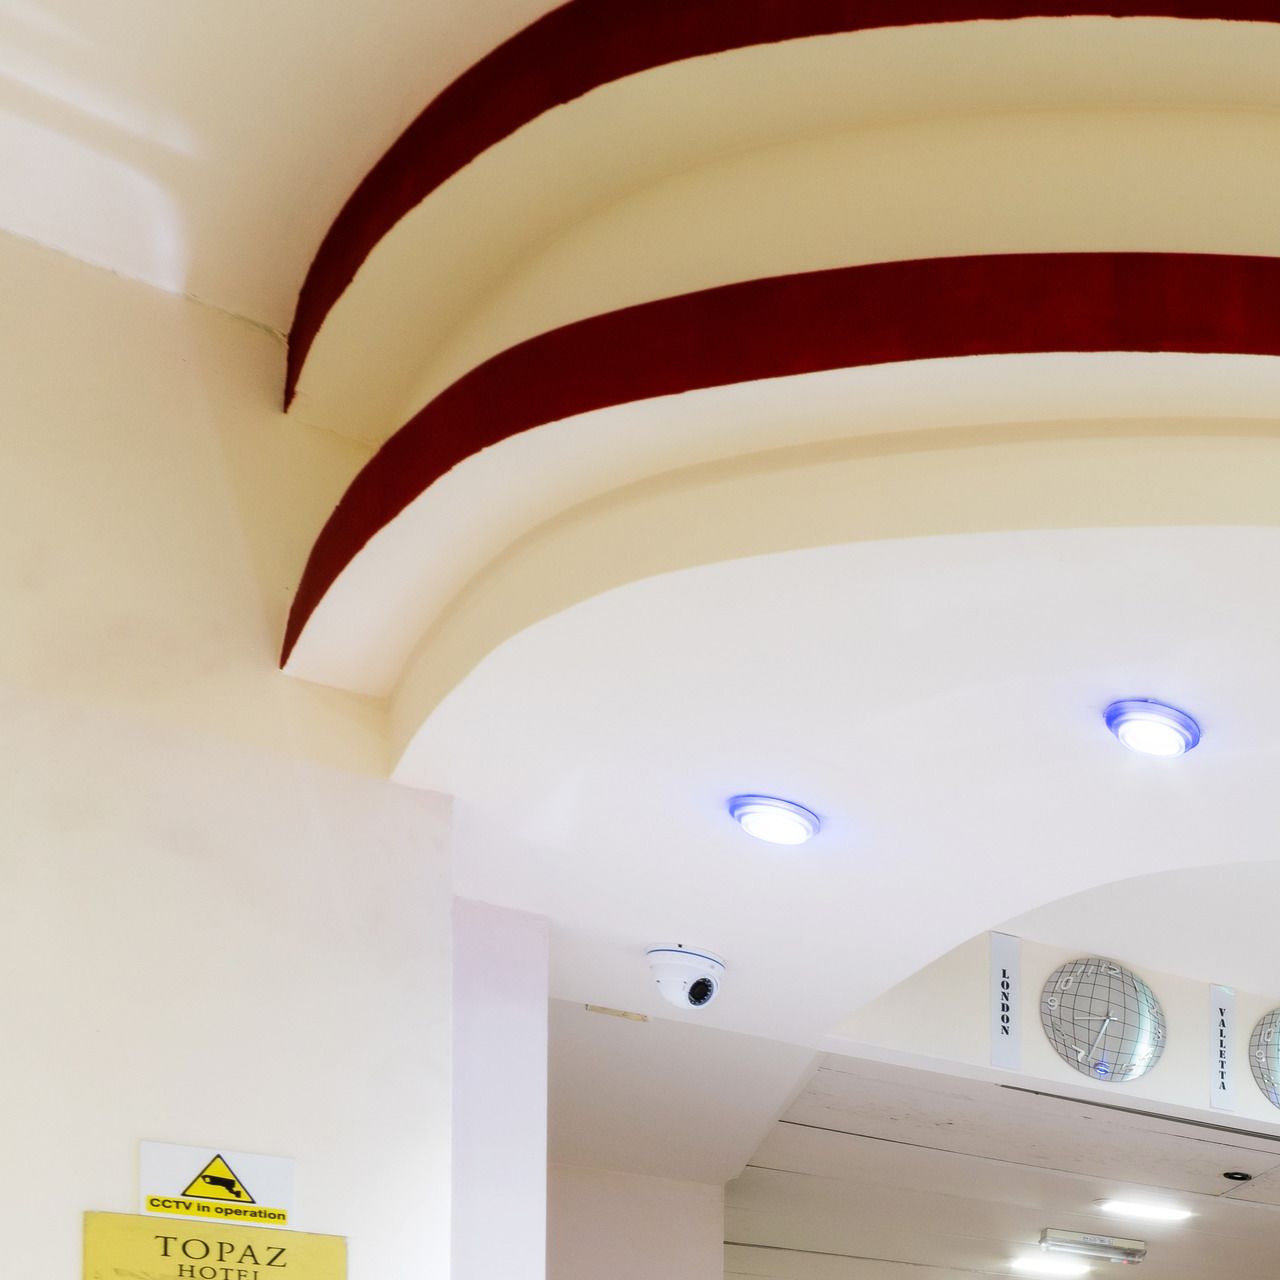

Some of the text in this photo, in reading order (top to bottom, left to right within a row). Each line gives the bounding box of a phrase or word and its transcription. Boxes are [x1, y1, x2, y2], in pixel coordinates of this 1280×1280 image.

[1001, 968, 1010, 1035] LONDON
[1218, 1008, 1227, 1090] VALLETTA
[150, 1198, 286, 1221] CCTV in operation
[154, 1235, 287, 1268] TOPAZ
